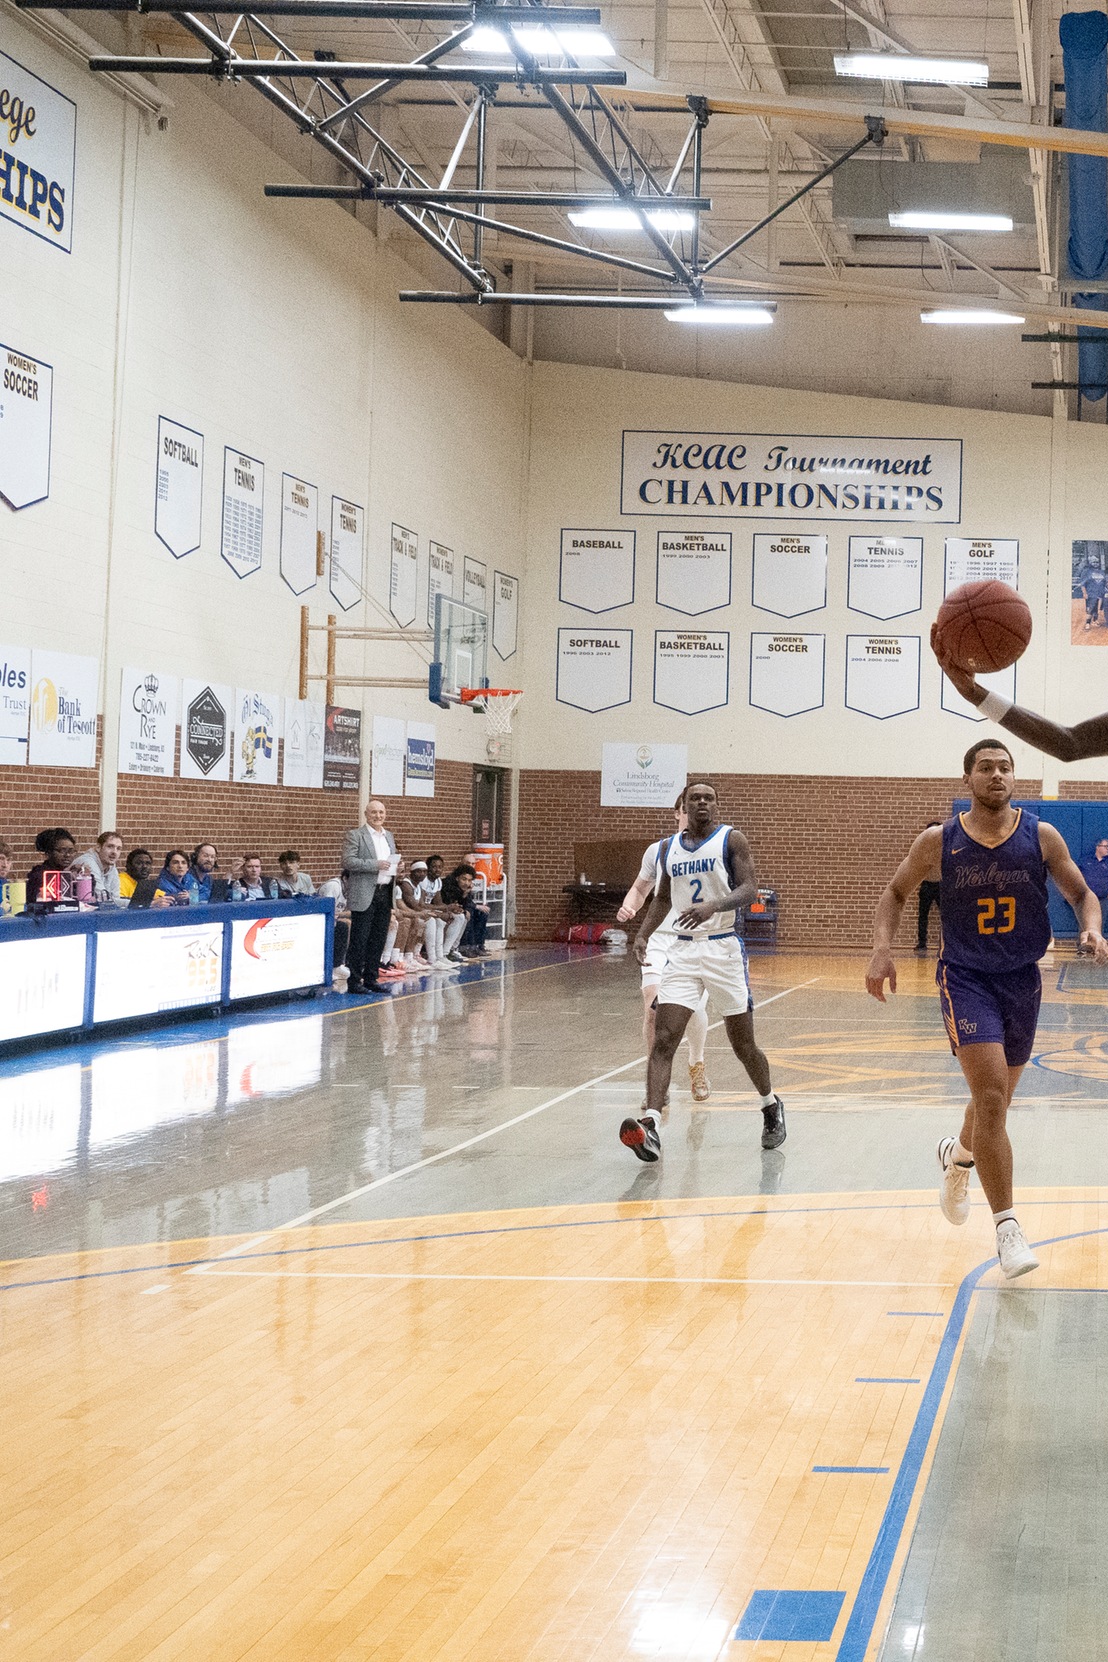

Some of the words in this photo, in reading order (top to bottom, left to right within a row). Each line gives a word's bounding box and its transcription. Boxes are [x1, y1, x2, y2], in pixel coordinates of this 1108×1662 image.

[7, 353, 37, 375] WOMEN'S
[3, 368, 39, 402] SOCCER
[163, 436, 199, 468] SOFTBALL
[652, 442, 748, 471] KCAC
[764, 445, 933, 476] Tournament
[234, 467, 256, 491] TENNIS
[291, 491, 310, 509] TENNIS
[639, 478, 944, 512] CHAMPIONSHIPS
[340, 513, 357, 534] TENNIS
[572, 539, 624, 550] BASEBALL
[662, 542, 727, 552] BASKETBALL
[770, 544, 811, 554] SOCCER
[867, 546, 904, 556] TENNIS
[968, 549, 995, 558] GOLF
[568, 638, 621, 649] SOFTBALL
[659, 641, 725, 651] BASKETBALL
[768, 643, 809, 653] SOCCER
[865, 646, 902, 655] TENNIS
[868, 638, 899, 646] WOMEN'S
[3, 695, 27, 710] Trust
[58, 696, 81, 717] Bank
[133, 685, 167, 716] CROWN
[57, 715, 66, 734] of
[67, 715, 95, 735] Tescott
[140, 713, 156, 740] RYE
[672, 858, 717, 878] BETHANY
[955, 862, 1030, 891] Wesleyan
[690, 879, 704, 904] 2
[977, 896, 1016, 935] 23
[958, 1018, 977, 1035] KW
